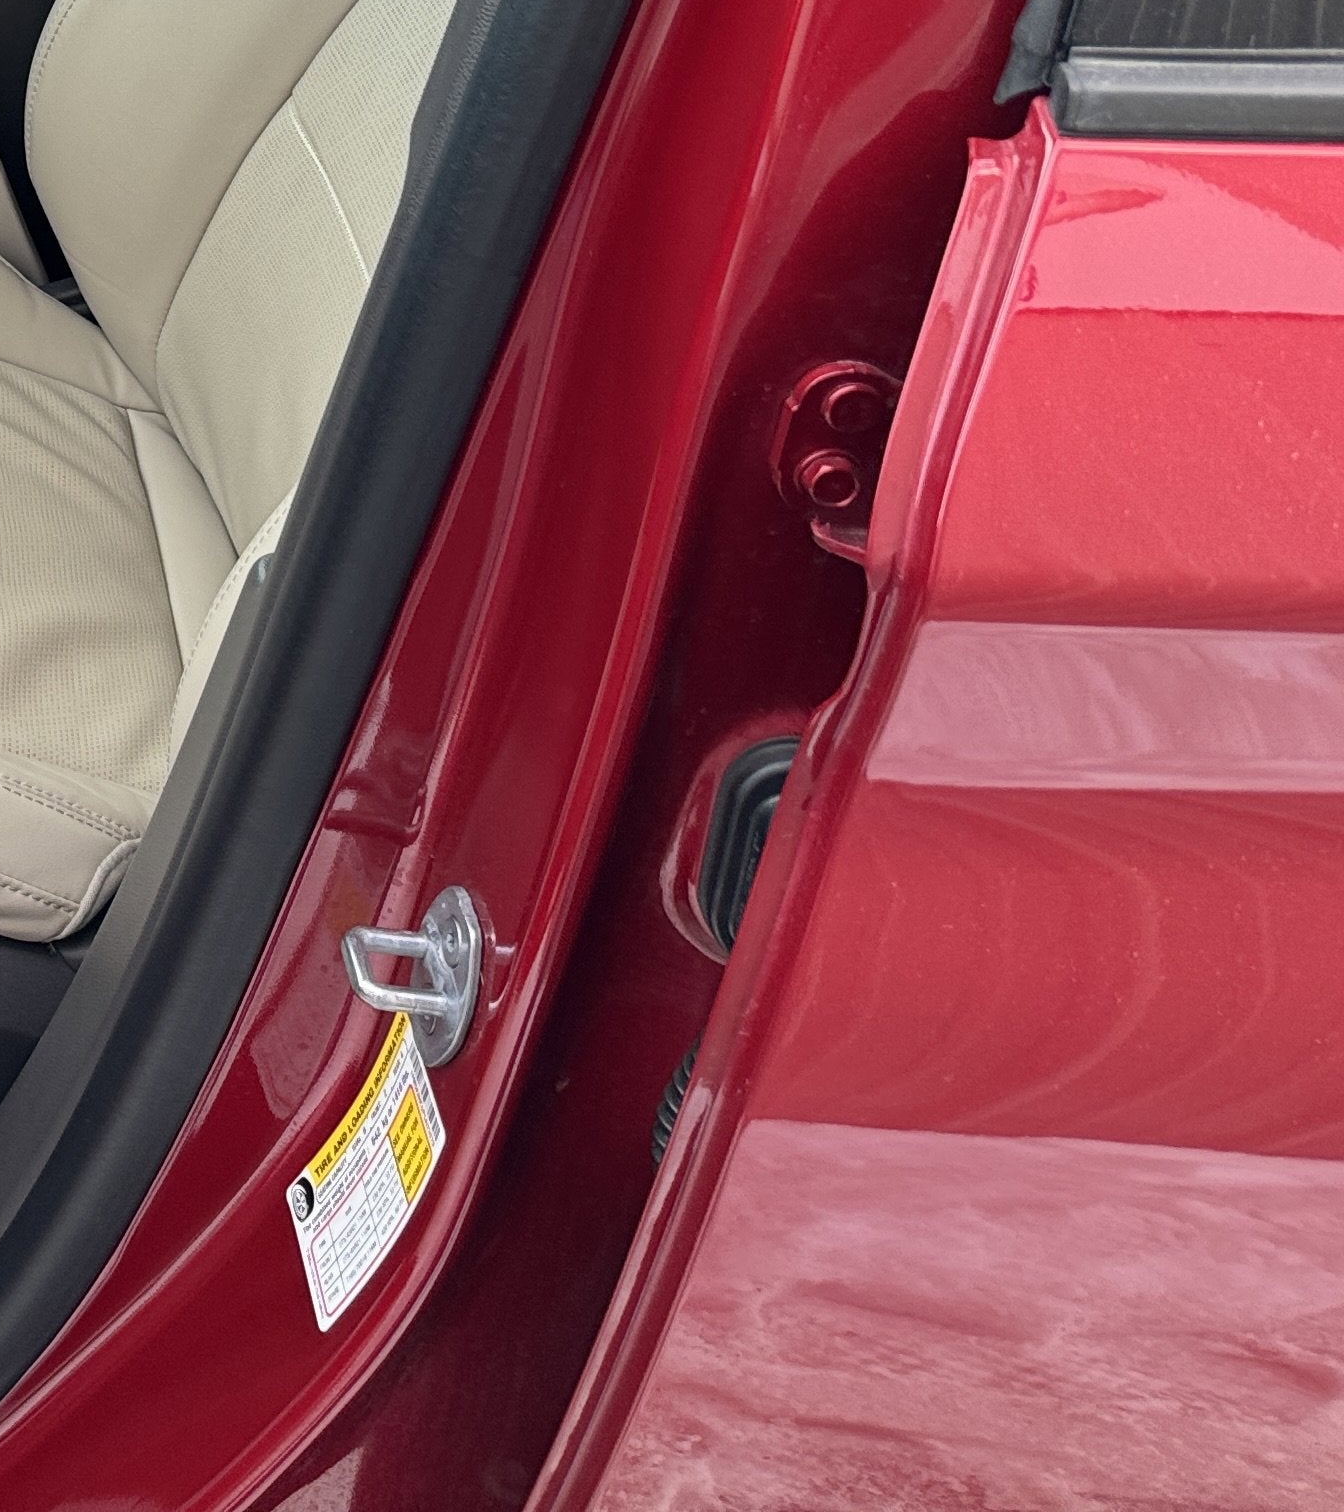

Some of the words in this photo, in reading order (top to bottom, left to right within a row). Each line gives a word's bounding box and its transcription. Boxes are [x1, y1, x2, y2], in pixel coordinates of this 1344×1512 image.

[314, 1153, 333, 1175] TIRE
[333, 1133, 347, 1156] AND
[349, 1087, 374, 1133] LOADING
[374, 1015, 405, 1089] INFORMATION
